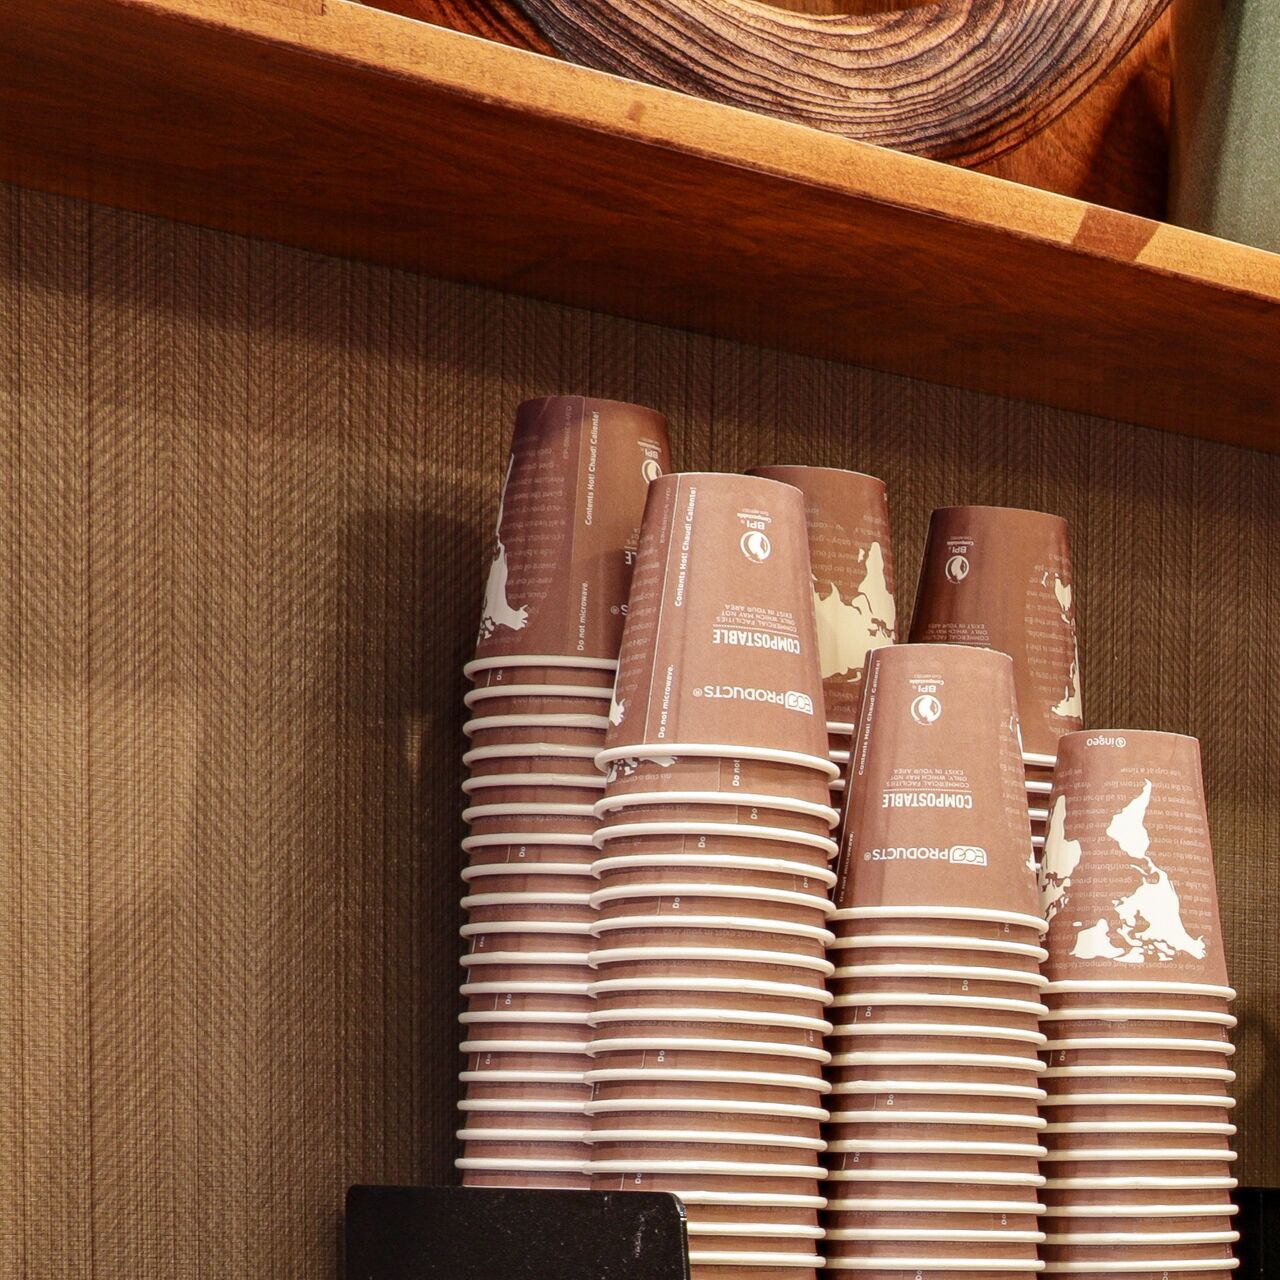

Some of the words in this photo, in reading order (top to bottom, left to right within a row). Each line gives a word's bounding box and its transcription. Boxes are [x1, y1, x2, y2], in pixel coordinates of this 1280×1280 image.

[589, 411, 600, 445] Caliente!
[588, 445, 597, 472] Chaud!
[586, 473, 595, 490] Hot!
[685, 486, 697, 522] Caliente!
[746, 520, 765, 530] BPI
[681, 523, 693, 551] Chaud!
[952, 546, 967, 554] BPI
[679, 552, 688, 570] Hot!
[674, 570, 687, 607] Contents
[579, 580, 589, 624] microwave.
[724, 603, 744, 612] AREA
[578, 624, 586, 638] not
[577, 639, 585, 651] Do
[712, 629, 800, 654] COMPOSTABLE
[663, 664, 674, 709] microwave.
[918, 685, 937, 693] BPI
[660, 711, 668, 725] not
[658, 727, 667, 739] Do
[1086, 735, 1115, 748] ingeo
[921, 780, 970, 789] COMMERCIAL
[882, 794, 973, 809] COMPOSTABLE
[750, 808, 758, 819] Do
[698, 836, 706, 847] Do
[672, 897, 680, 908] Do
[961, 979, 969, 991] Do
[865, 1006, 872, 1017] Do
[657, 1050, 665, 1062] Do
[886, 1094, 894, 1106] Do
[635, 1172, 642, 1184] Do
